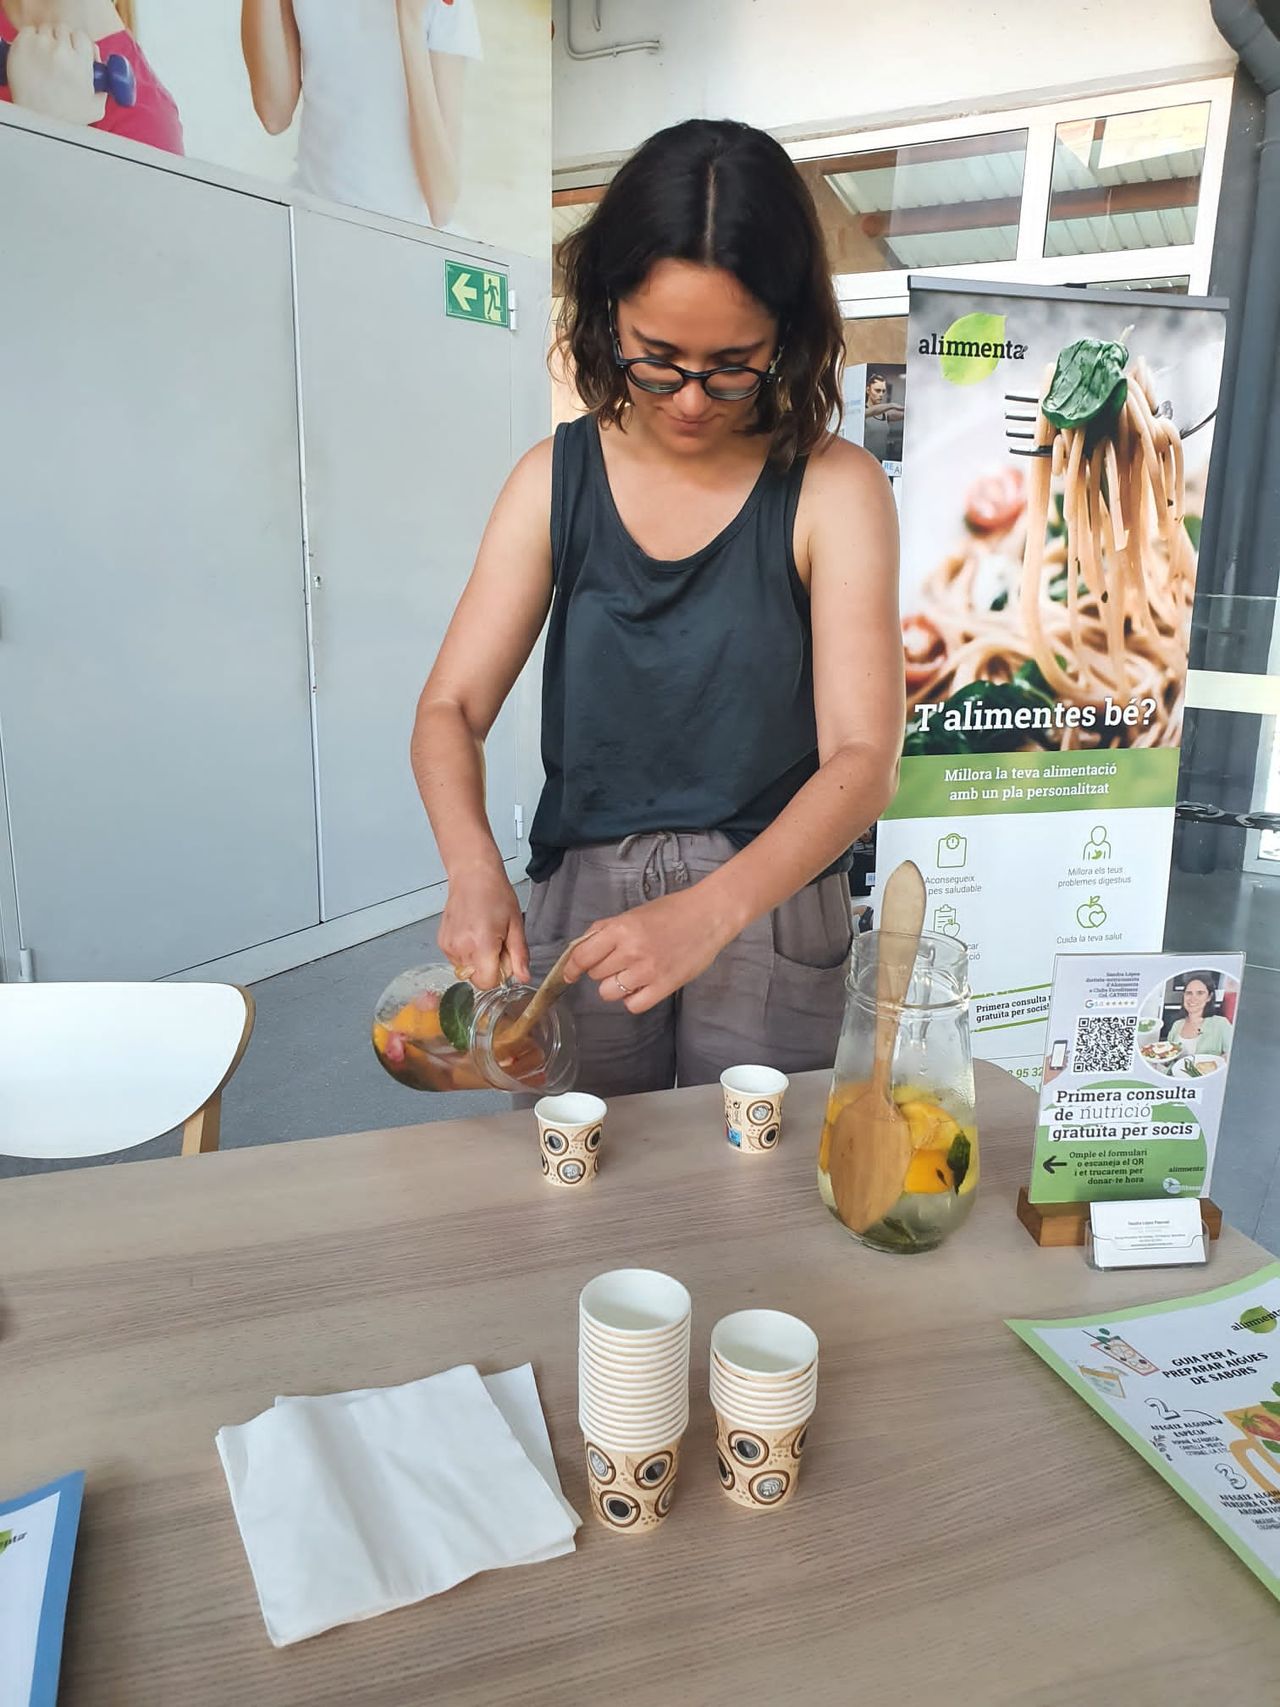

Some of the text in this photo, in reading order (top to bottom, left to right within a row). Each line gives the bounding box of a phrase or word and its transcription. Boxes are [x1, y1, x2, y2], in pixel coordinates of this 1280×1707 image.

[919, 333, 1028, 360] alimmenta
[914, 696, 1157, 732] T'alimentes bé?
[944, 762, 1118, 782] Millora la teva alimentació
[950, 781, 1110, 801] amb un pla personalitzat
[925, 875, 976, 885] Aconsegueix
[1067, 866, 1124, 877] Millora els teus
[928, 883, 982, 897] pes saludable
[1057, 876, 1132, 888] problemes digestius
[1056, 931, 1123, 945] Cuida la teva salut
[976, 995, 1048, 1014] Primera consulta
[1011, 1008, 1026, 1019] per
[1016, 1068, 1029, 1079] 95
[1055, 1086, 1197, 1104] Primera consulta
[1054, 1104, 1151, 1122] de nutrició
[1052, 1121, 1194, 1143] gratuïta per socis
[1069, 1149, 1148, 1160] Omple el formulari
[1084, 1159, 1121, 1169] escaneja
[1122, 1158, 1130, 1167] el
[1131, 1158, 1145, 1167] QR
[1078, 1169, 1088, 1177] et
[1089, 1168, 1128, 1177] trucarem
[1129, 1168, 1144, 1177] per
[1087, 1176, 1145, 1185] donar-te hora
[1171, 1348, 1238, 1368] GUIA PER A
[1161, 1361, 1225, 1379] PREPARAR
[1189, 1366, 1258, 1386] DE SABORS
[1143, 1397, 1181, 1421] 2
[1214, 1462, 1248, 1490] 3
